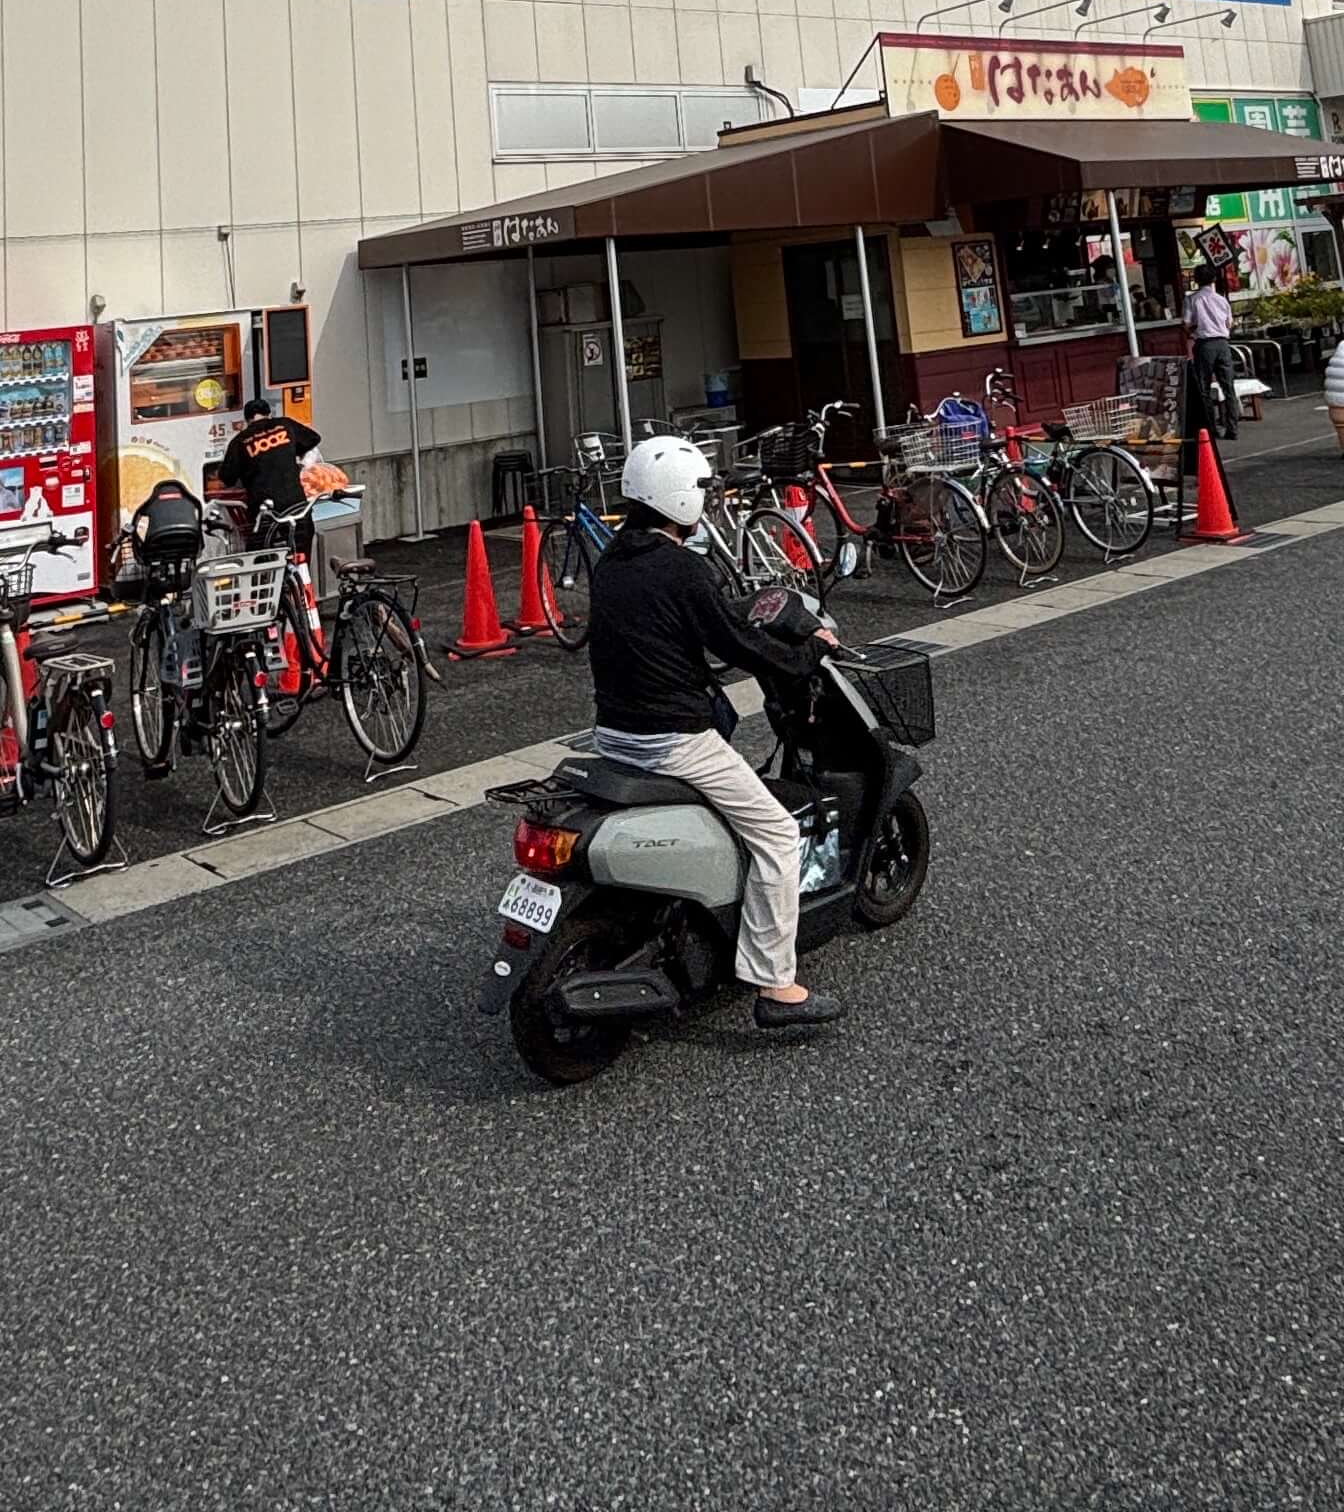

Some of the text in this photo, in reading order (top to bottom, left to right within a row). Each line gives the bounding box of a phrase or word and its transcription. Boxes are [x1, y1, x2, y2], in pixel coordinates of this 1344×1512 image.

[208, 423, 226, 438] 45
[632, 838, 681, 849] TACT
[510, 895, 553, 926] 68899
